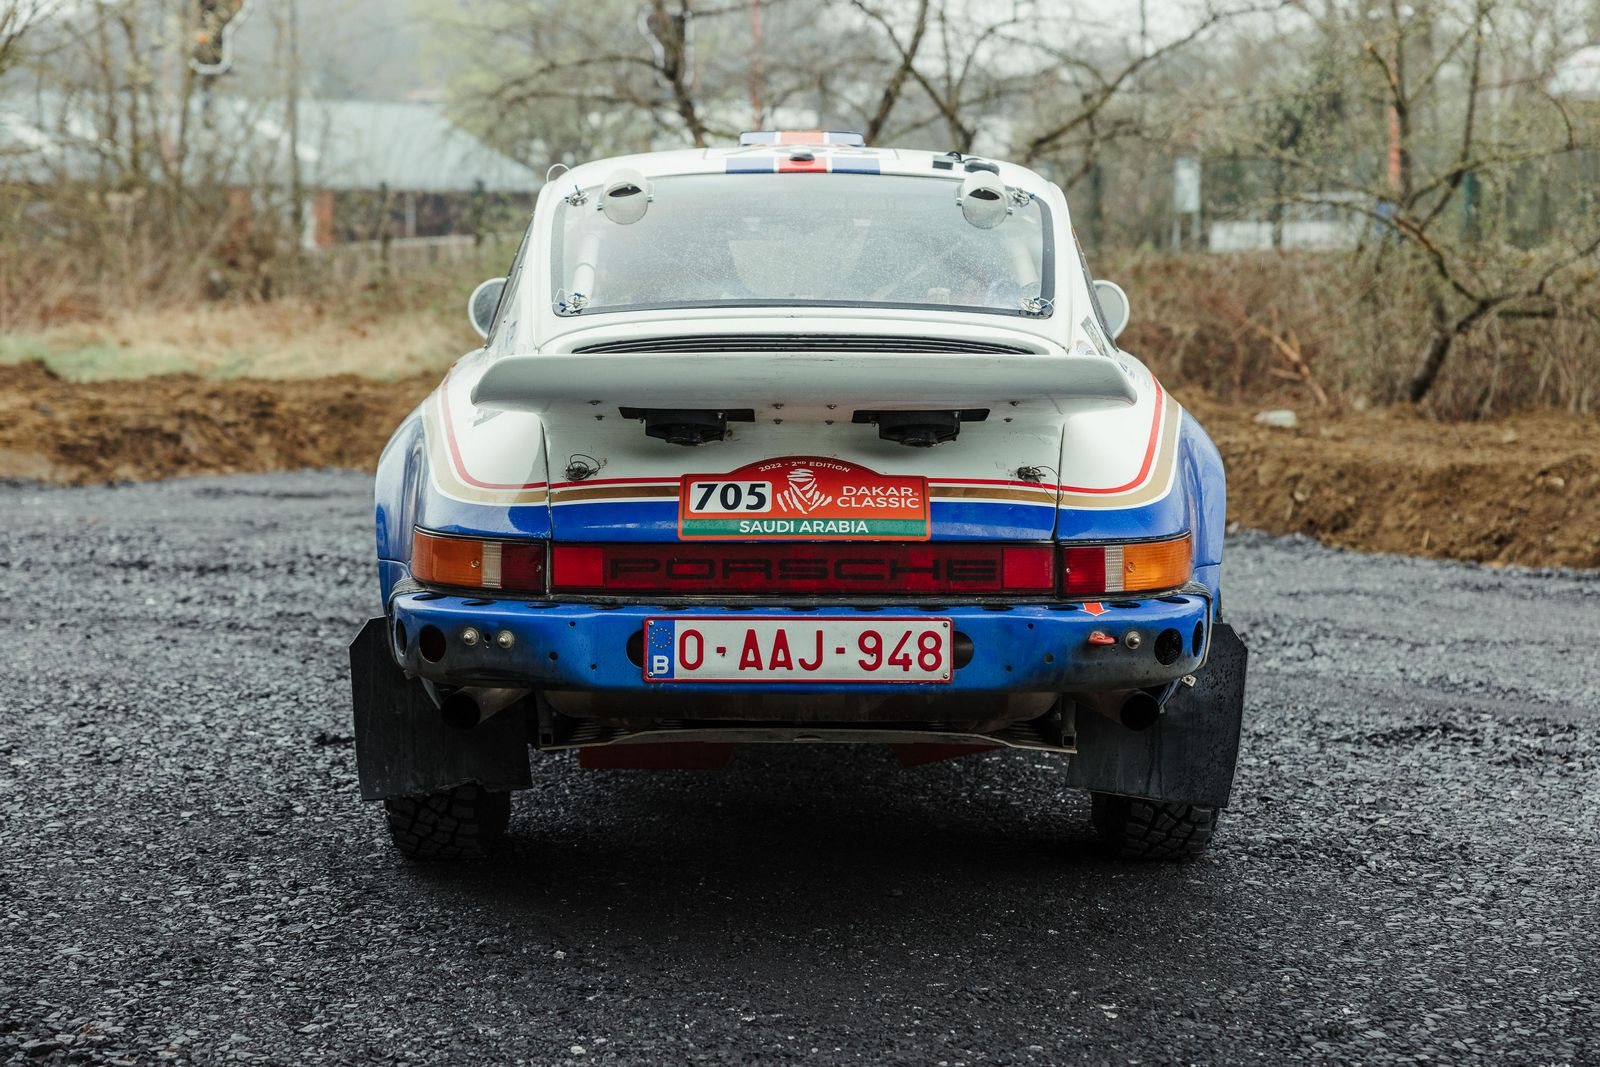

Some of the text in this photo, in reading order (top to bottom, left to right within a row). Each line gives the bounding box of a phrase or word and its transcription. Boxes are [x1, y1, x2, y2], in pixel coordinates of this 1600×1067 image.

[759, 462, 782, 472] 2022
[809, 461, 850, 473] EDITION
[695, 483, 767, 510] 705
[842, 486, 913, 496] DAKAR
[836, 496, 919, 508] CLASSIC
[740, 521, 869, 533] SAUDI ARABIA
[610, 558, 998, 580] PORSCHE
[653, 655, 669, 674] B
